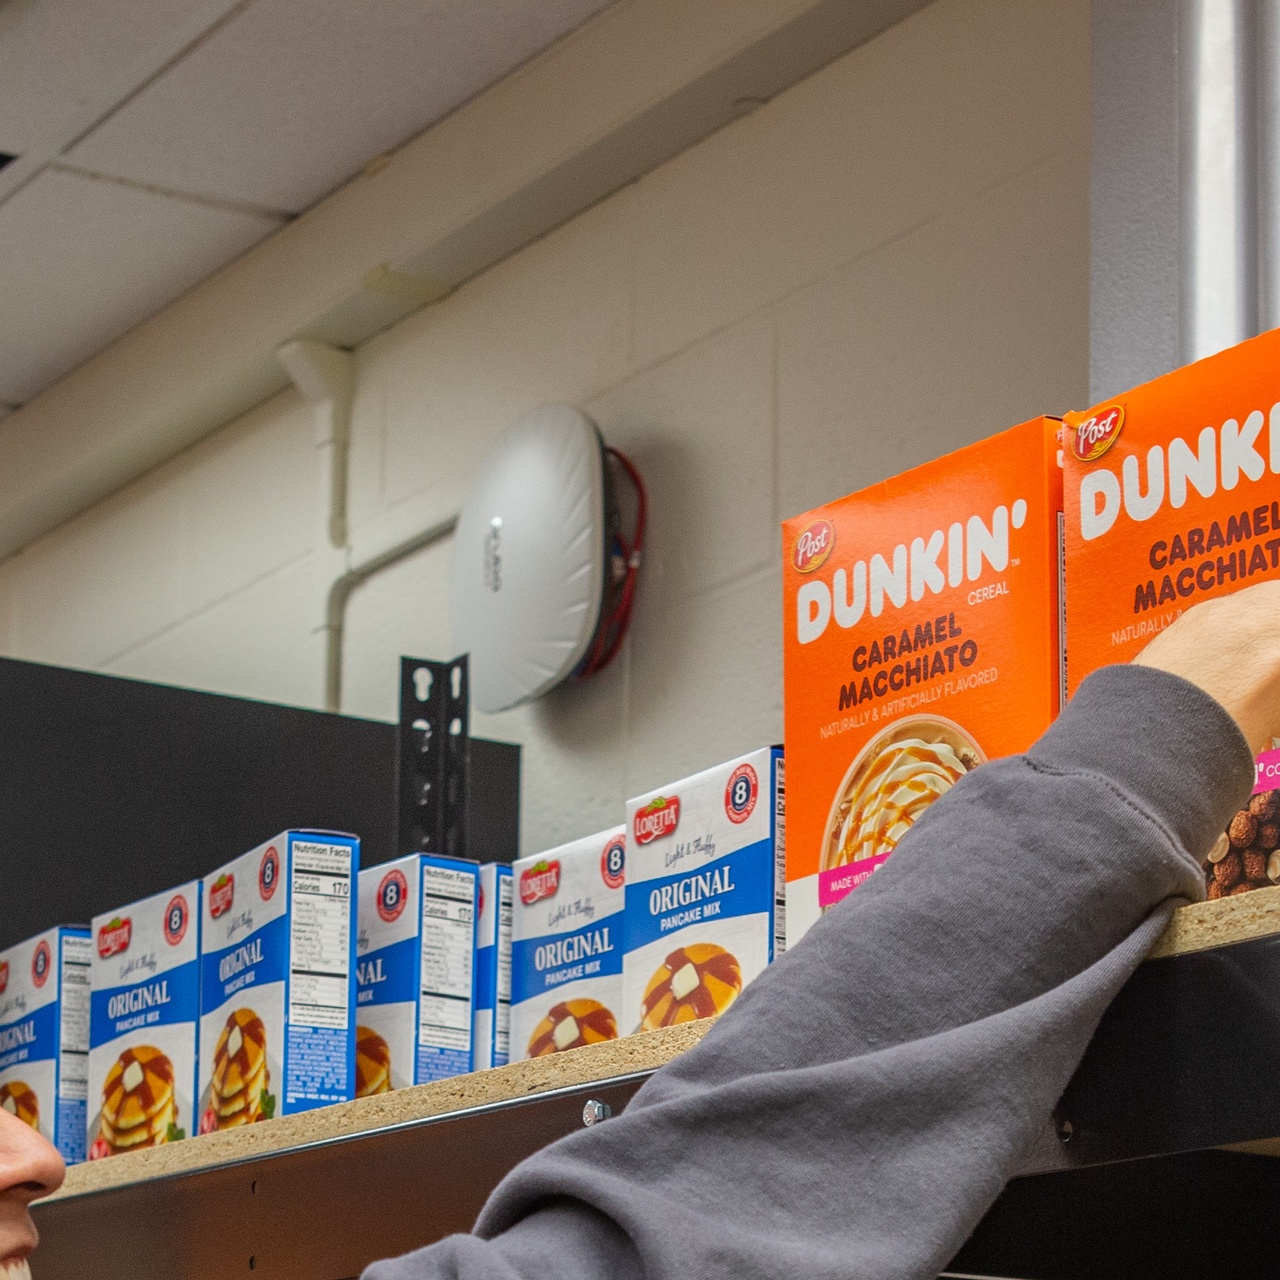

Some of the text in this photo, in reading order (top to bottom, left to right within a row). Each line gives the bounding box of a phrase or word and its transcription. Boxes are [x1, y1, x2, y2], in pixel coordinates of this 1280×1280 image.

[1078, 410, 1117, 455] Post
[797, 528, 829, 562] Post
[797, 499, 1027, 645] DUNKIN'
[967, 582, 1009, 606] CEREAL
[852, 612, 962, 672] CARAMEL
[838, 639, 977, 711] MACCHIATO
[820, 710, 872, 740] NATURALLY
[880, 686, 941, 719] ARTIFICIALLY
[944, 668, 998, 698] FLAVORED
[734, 780, 747, 804] 8
[635, 805, 677, 836] LORETTA
[293, 842, 351, 859] Nutrition Facts
[610, 849, 621, 871] 8
[263, 862, 273, 882] 8
[293, 881, 350, 895] Calories 170
[385, 886, 398, 906] 8
[650, 866, 735, 916] ORIGINAL
[170, 910, 181, 929] 8
[660, 901, 721, 931] PANCAKE MIX
[219, 938, 264, 983] ORIGINAL
[534, 928, 614, 971] ORIGINAL
[545, 961, 601, 986] PANCAKE MIX
[108, 980, 170, 1020] ORIGINAL
[116, 1010, 160, 1032] PANCAKE MIX
